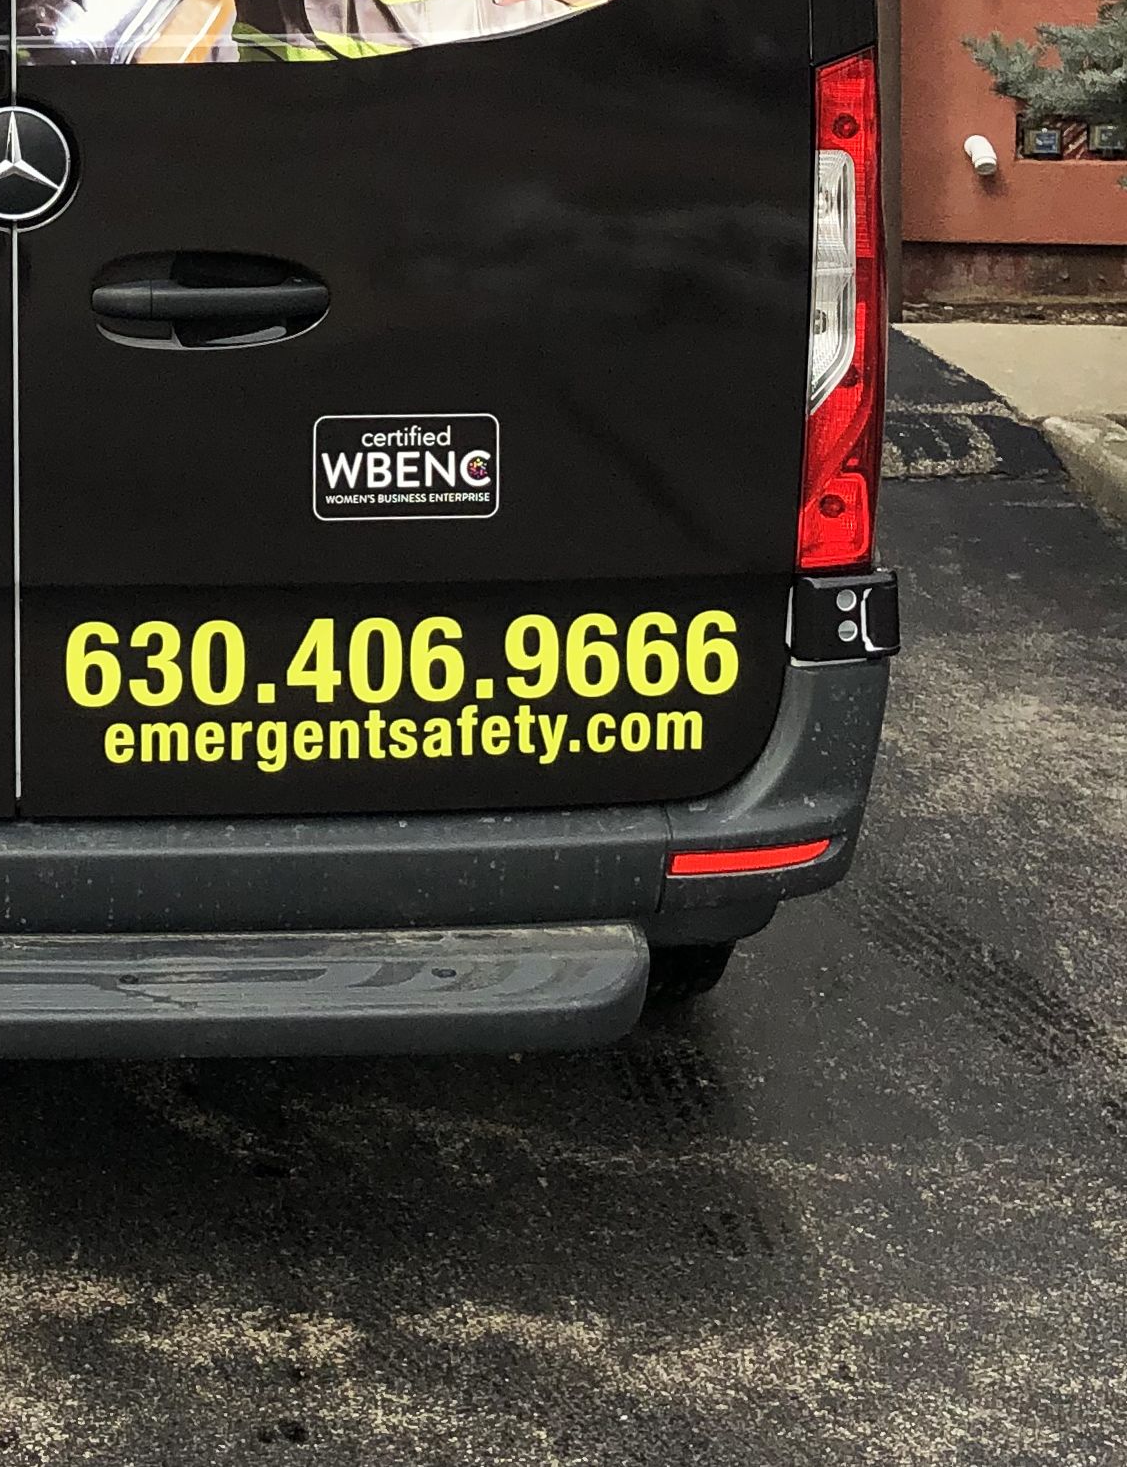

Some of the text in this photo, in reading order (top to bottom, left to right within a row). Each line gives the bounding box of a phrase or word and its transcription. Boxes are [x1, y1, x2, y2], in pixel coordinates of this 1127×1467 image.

[362, 425, 450, 447] certified
[322, 450, 491, 489] WBENC
[326, 493, 490, 504] WOMEN'S BUSINESS ENTERPRISE
[66, 610, 739, 708] 630.406.9666
[105, 704, 703, 772] emergentsafety.com
